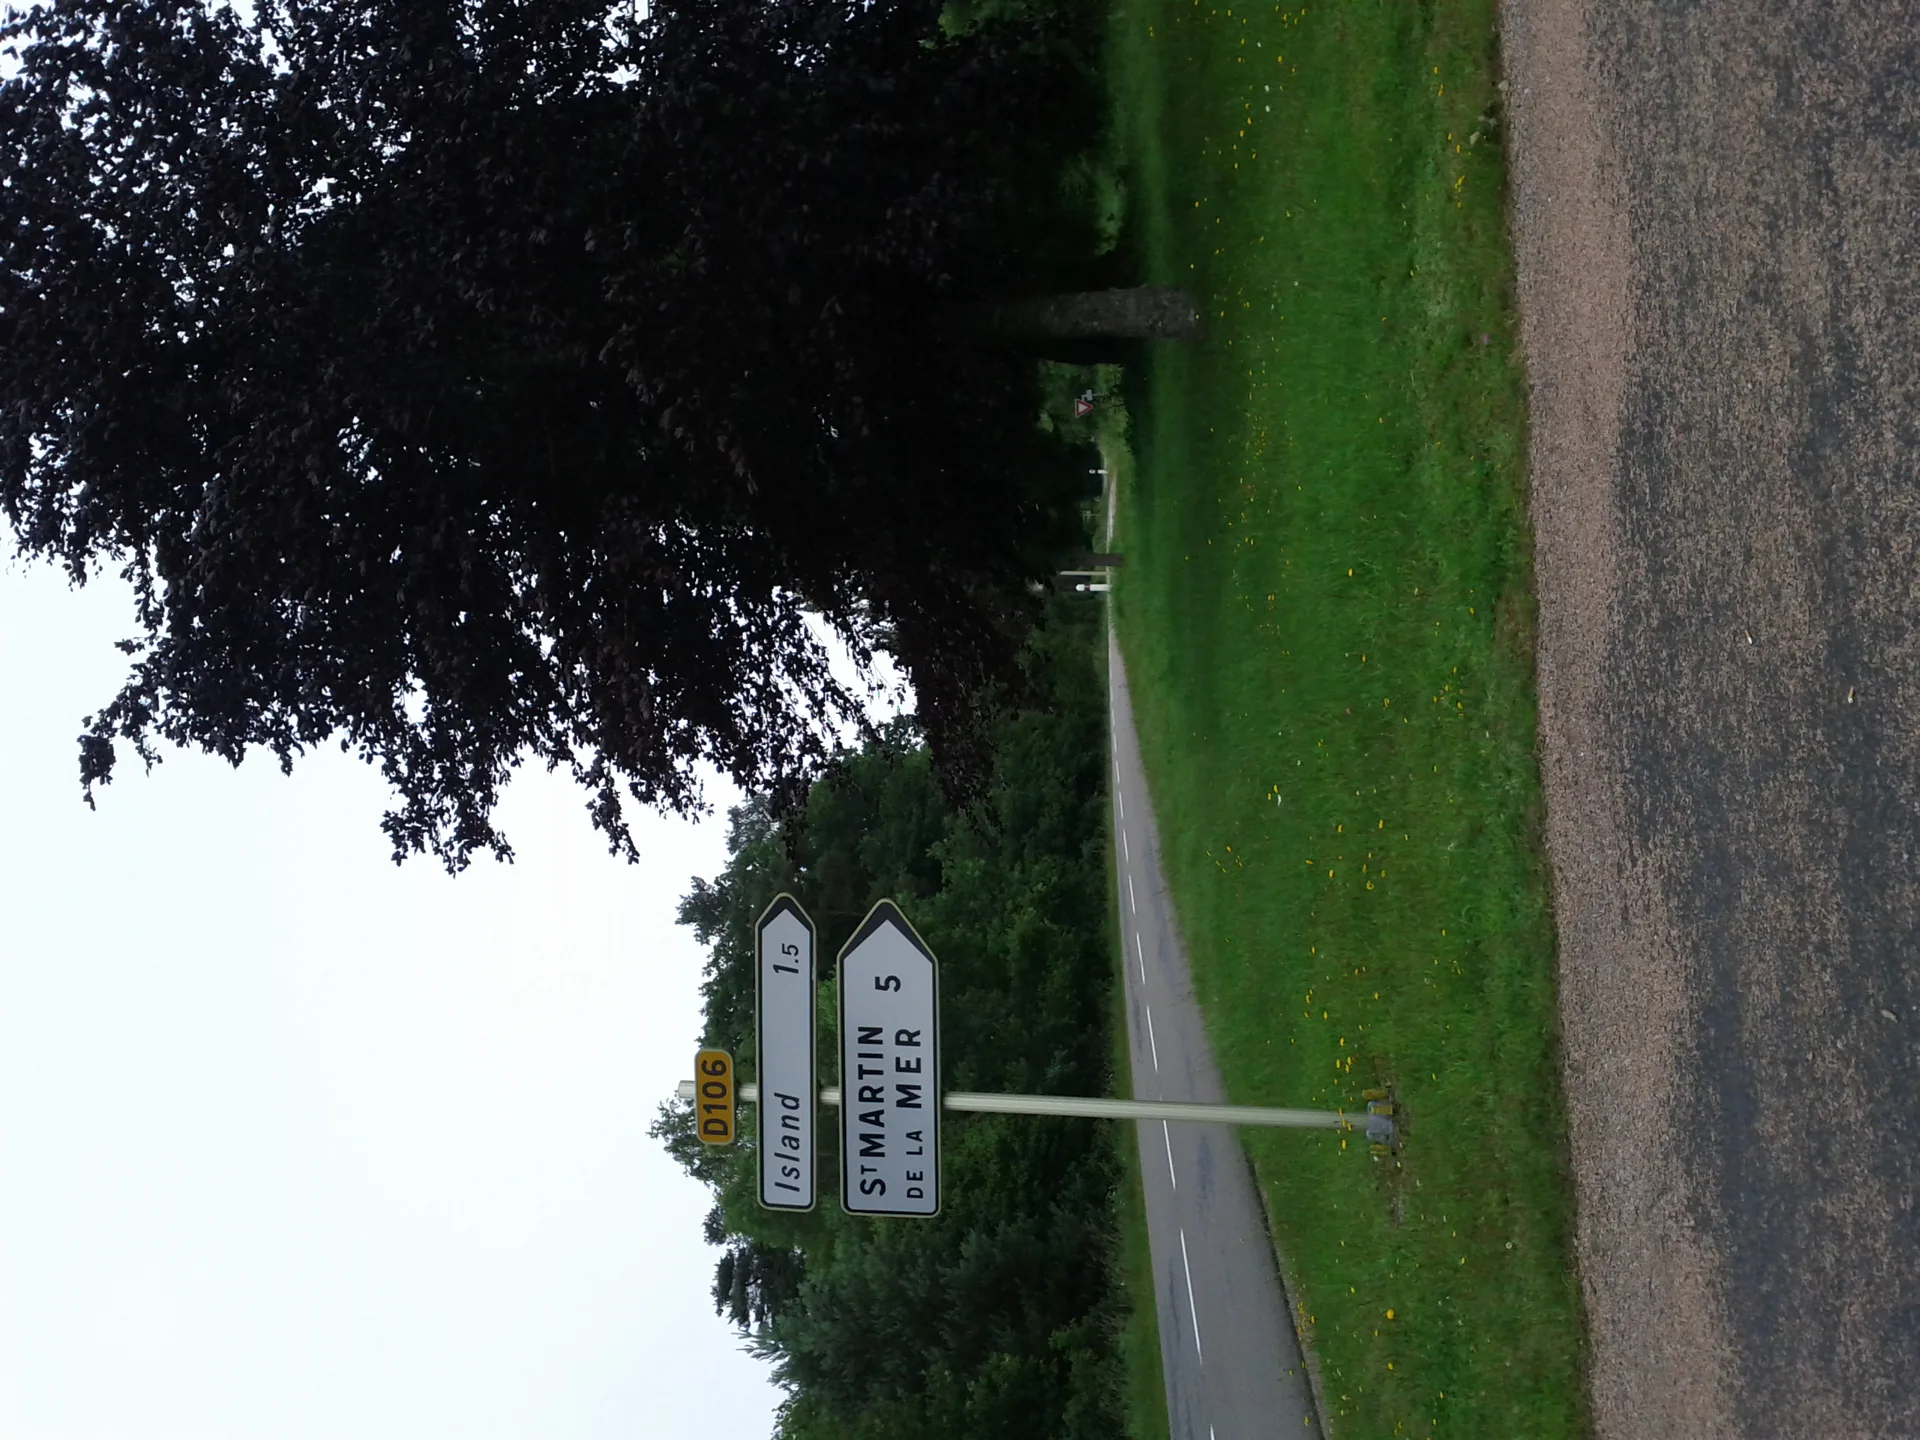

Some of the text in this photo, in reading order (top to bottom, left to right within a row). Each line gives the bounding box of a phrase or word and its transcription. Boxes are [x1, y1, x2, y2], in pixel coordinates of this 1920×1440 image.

[874, 975, 902, 993] 5
[701, 1059, 729, 1136] D106
[773, 943, 800, 1193] Island 1.5
[857, 1026, 886, 1158] MARTIN
[895, 1029, 924, 1199] DE LA MER
